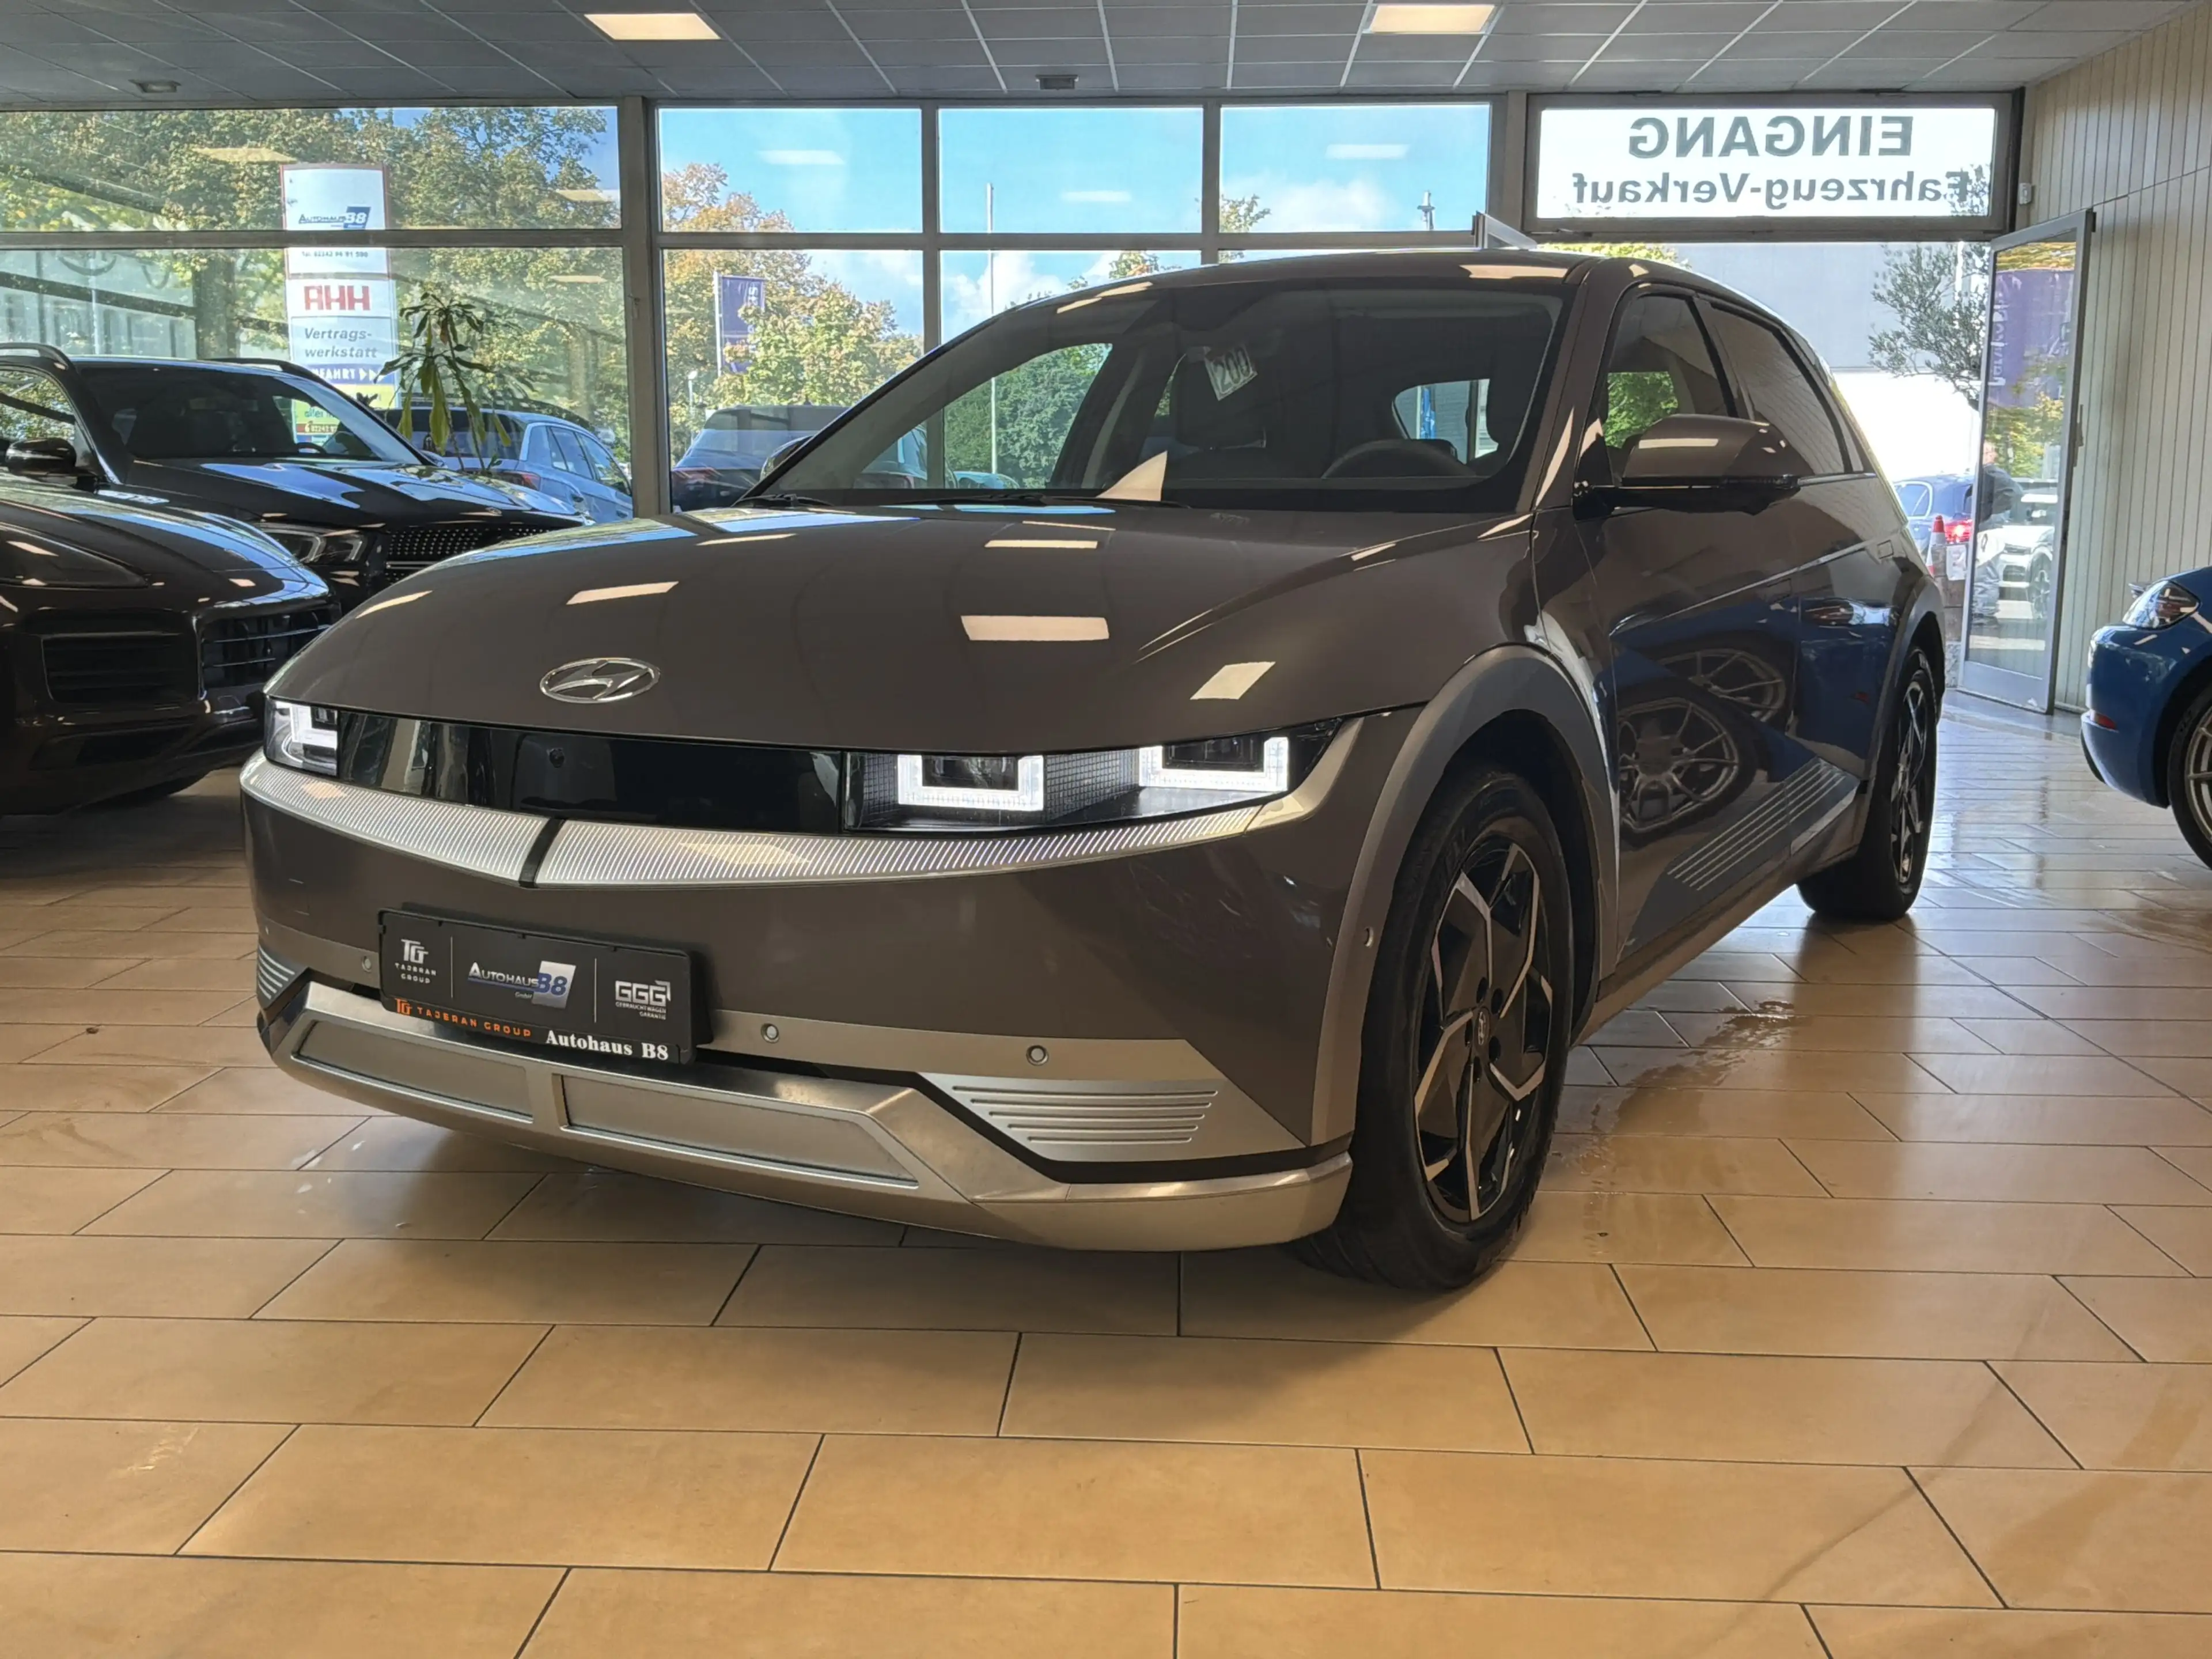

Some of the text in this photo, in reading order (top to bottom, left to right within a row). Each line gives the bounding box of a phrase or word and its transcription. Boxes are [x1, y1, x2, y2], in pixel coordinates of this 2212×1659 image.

[304, 285, 370, 310] AHH
[305, 327, 372, 342] Vertrags-
[305, 346, 378, 358] werkstatt
[615, 980, 666, 1007] GGG
[483, 1021, 531, 1037] GROUP
[546, 1030, 669, 1060] Autohaus B8
